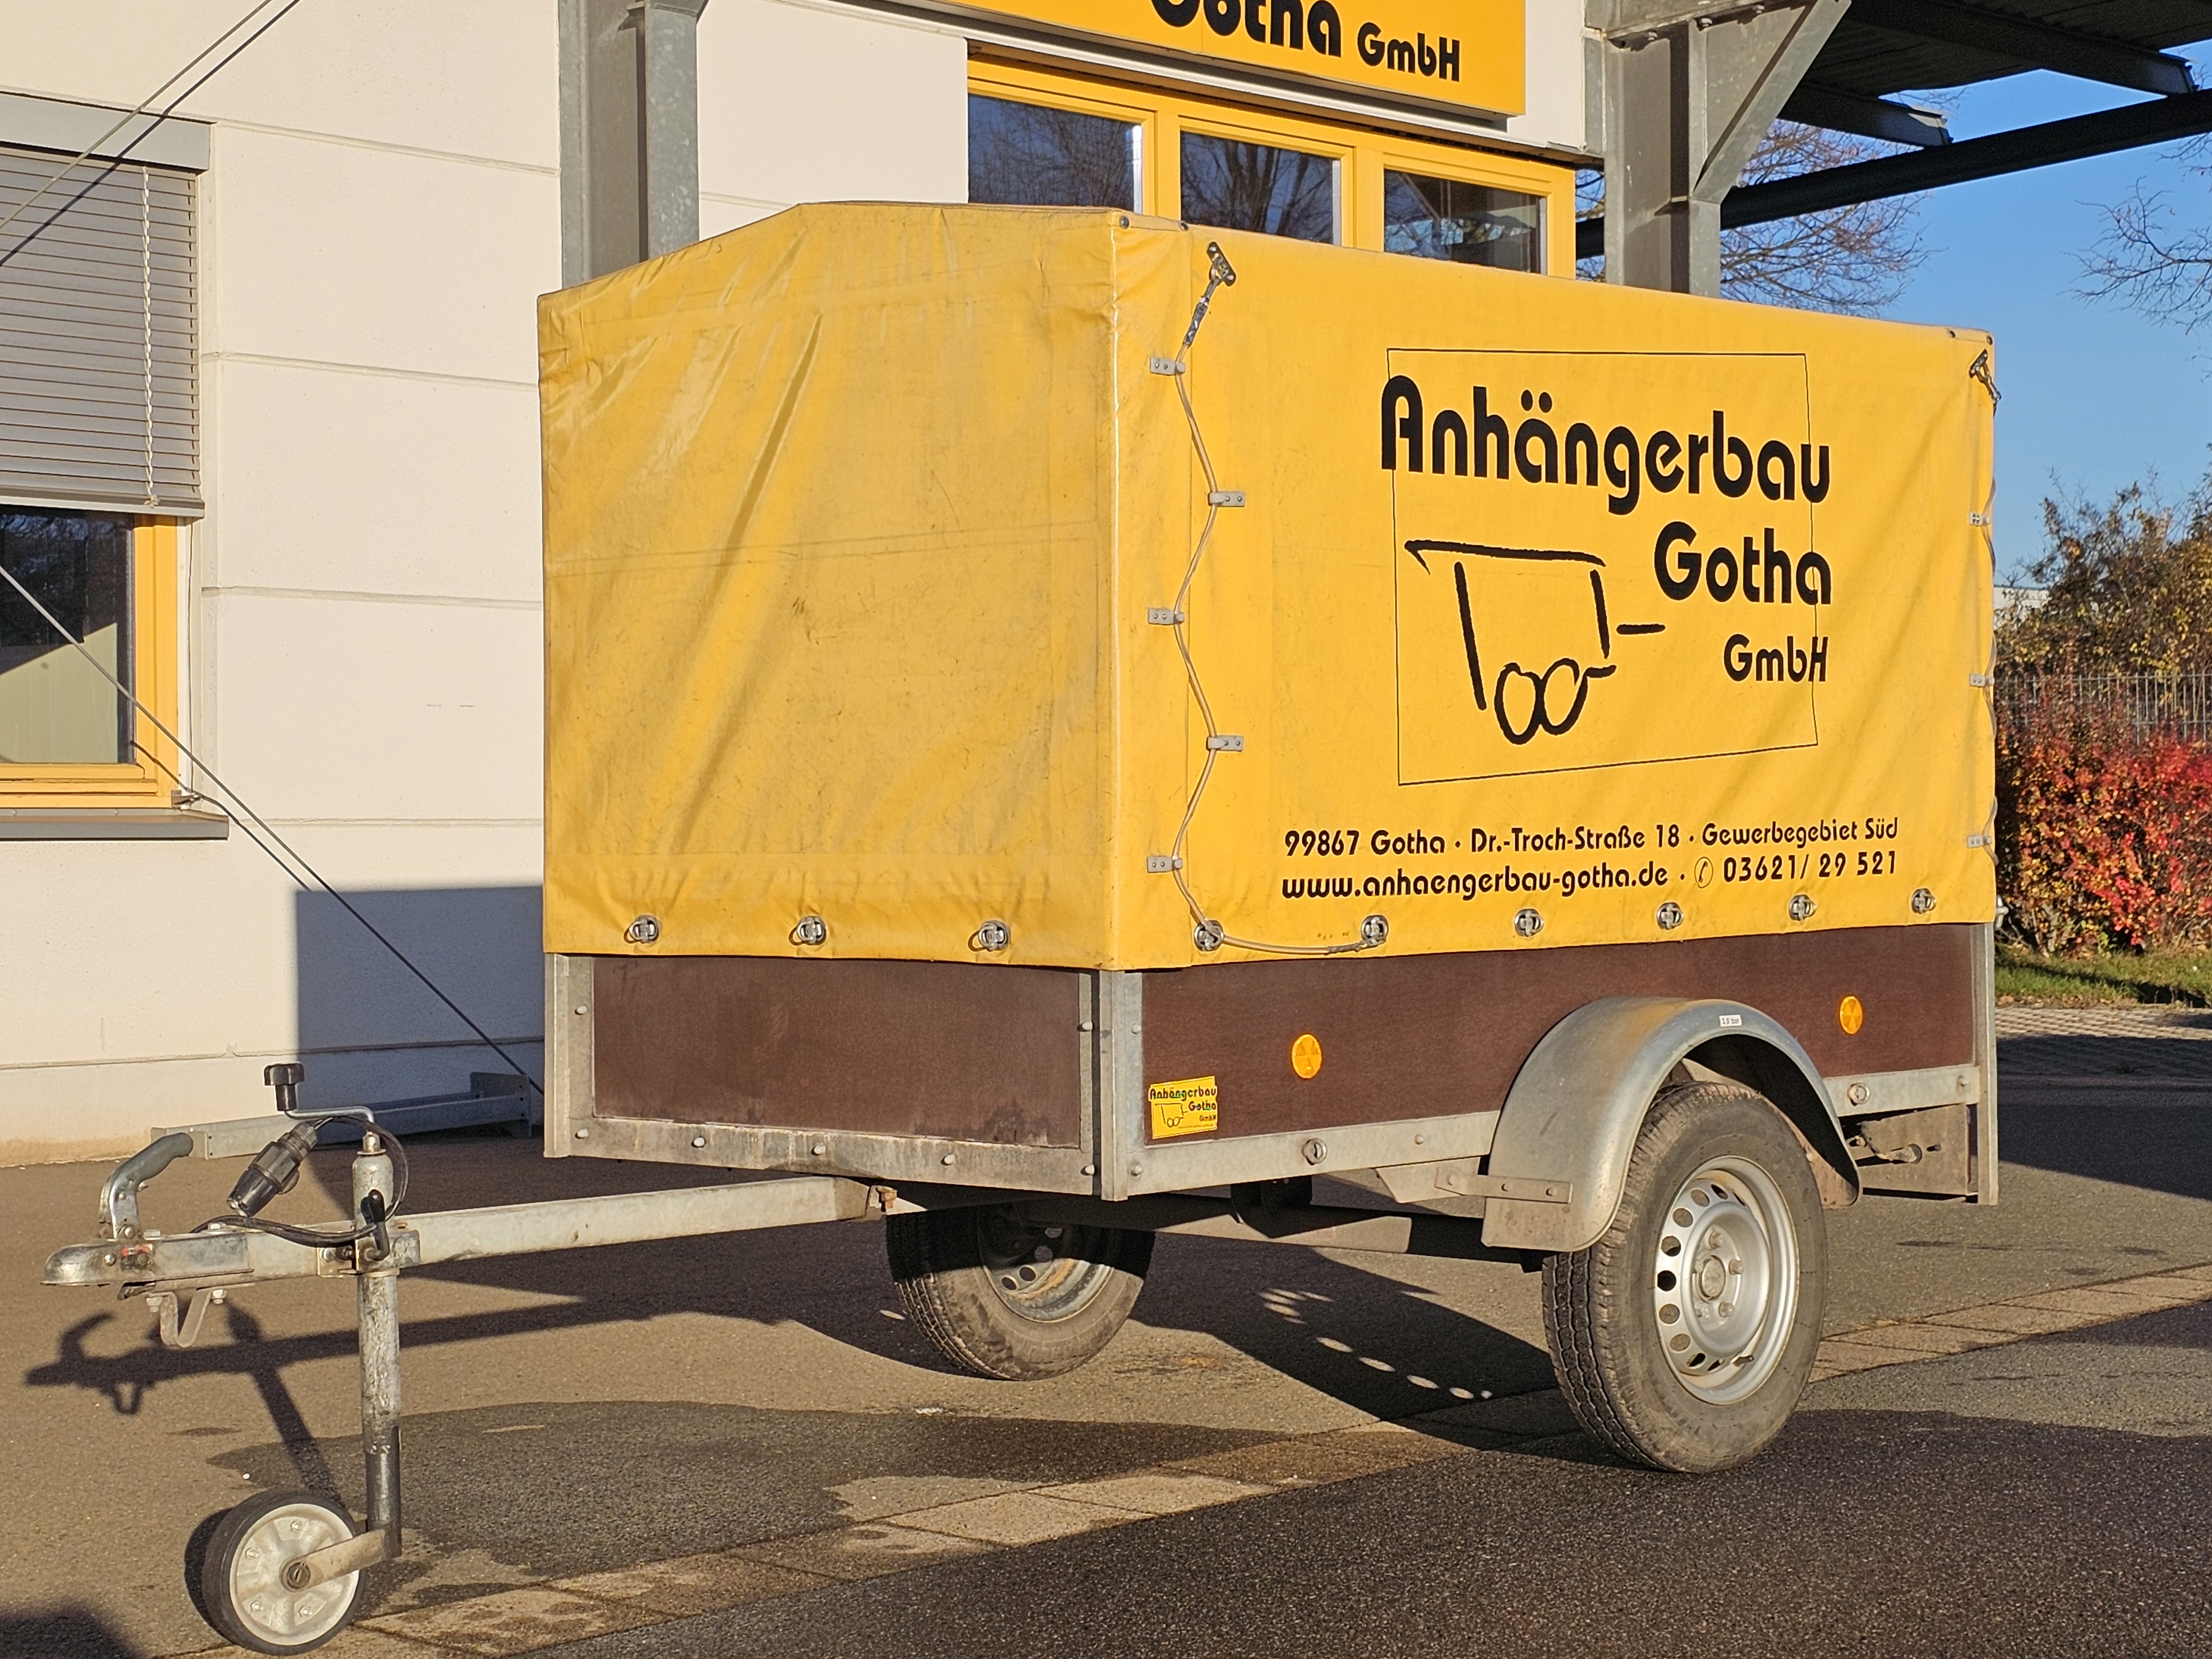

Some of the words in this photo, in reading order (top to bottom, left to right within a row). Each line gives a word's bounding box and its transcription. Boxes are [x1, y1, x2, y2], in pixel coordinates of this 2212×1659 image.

[1357, 22, 1460, 82] GmbH
[1381, 375, 1830, 515] Anhängerbau
[1654, 521, 1831, 605] Gotha
[1723, 633, 1829, 682] GmbH
[1285, 830, 1359, 856] 99867
[1371, 829, 1445, 855] Gotha
[1472, 825, 1645, 852] Dr.-Troch-Straße
[1656, 824, 1679, 848] 18
[1702, 818, 1858, 849] Gewerbegebiet
[1865, 817, 1898, 839] Süd
[1282, 861, 1668, 901] www.anhaengerbau-gotha.de
[1724, 854, 1809, 883] 03621/
[1819, 852, 1846, 878] 29
[1857, 851, 1895, 875] 521
[1188, 1100, 1216, 1111] Gotha
